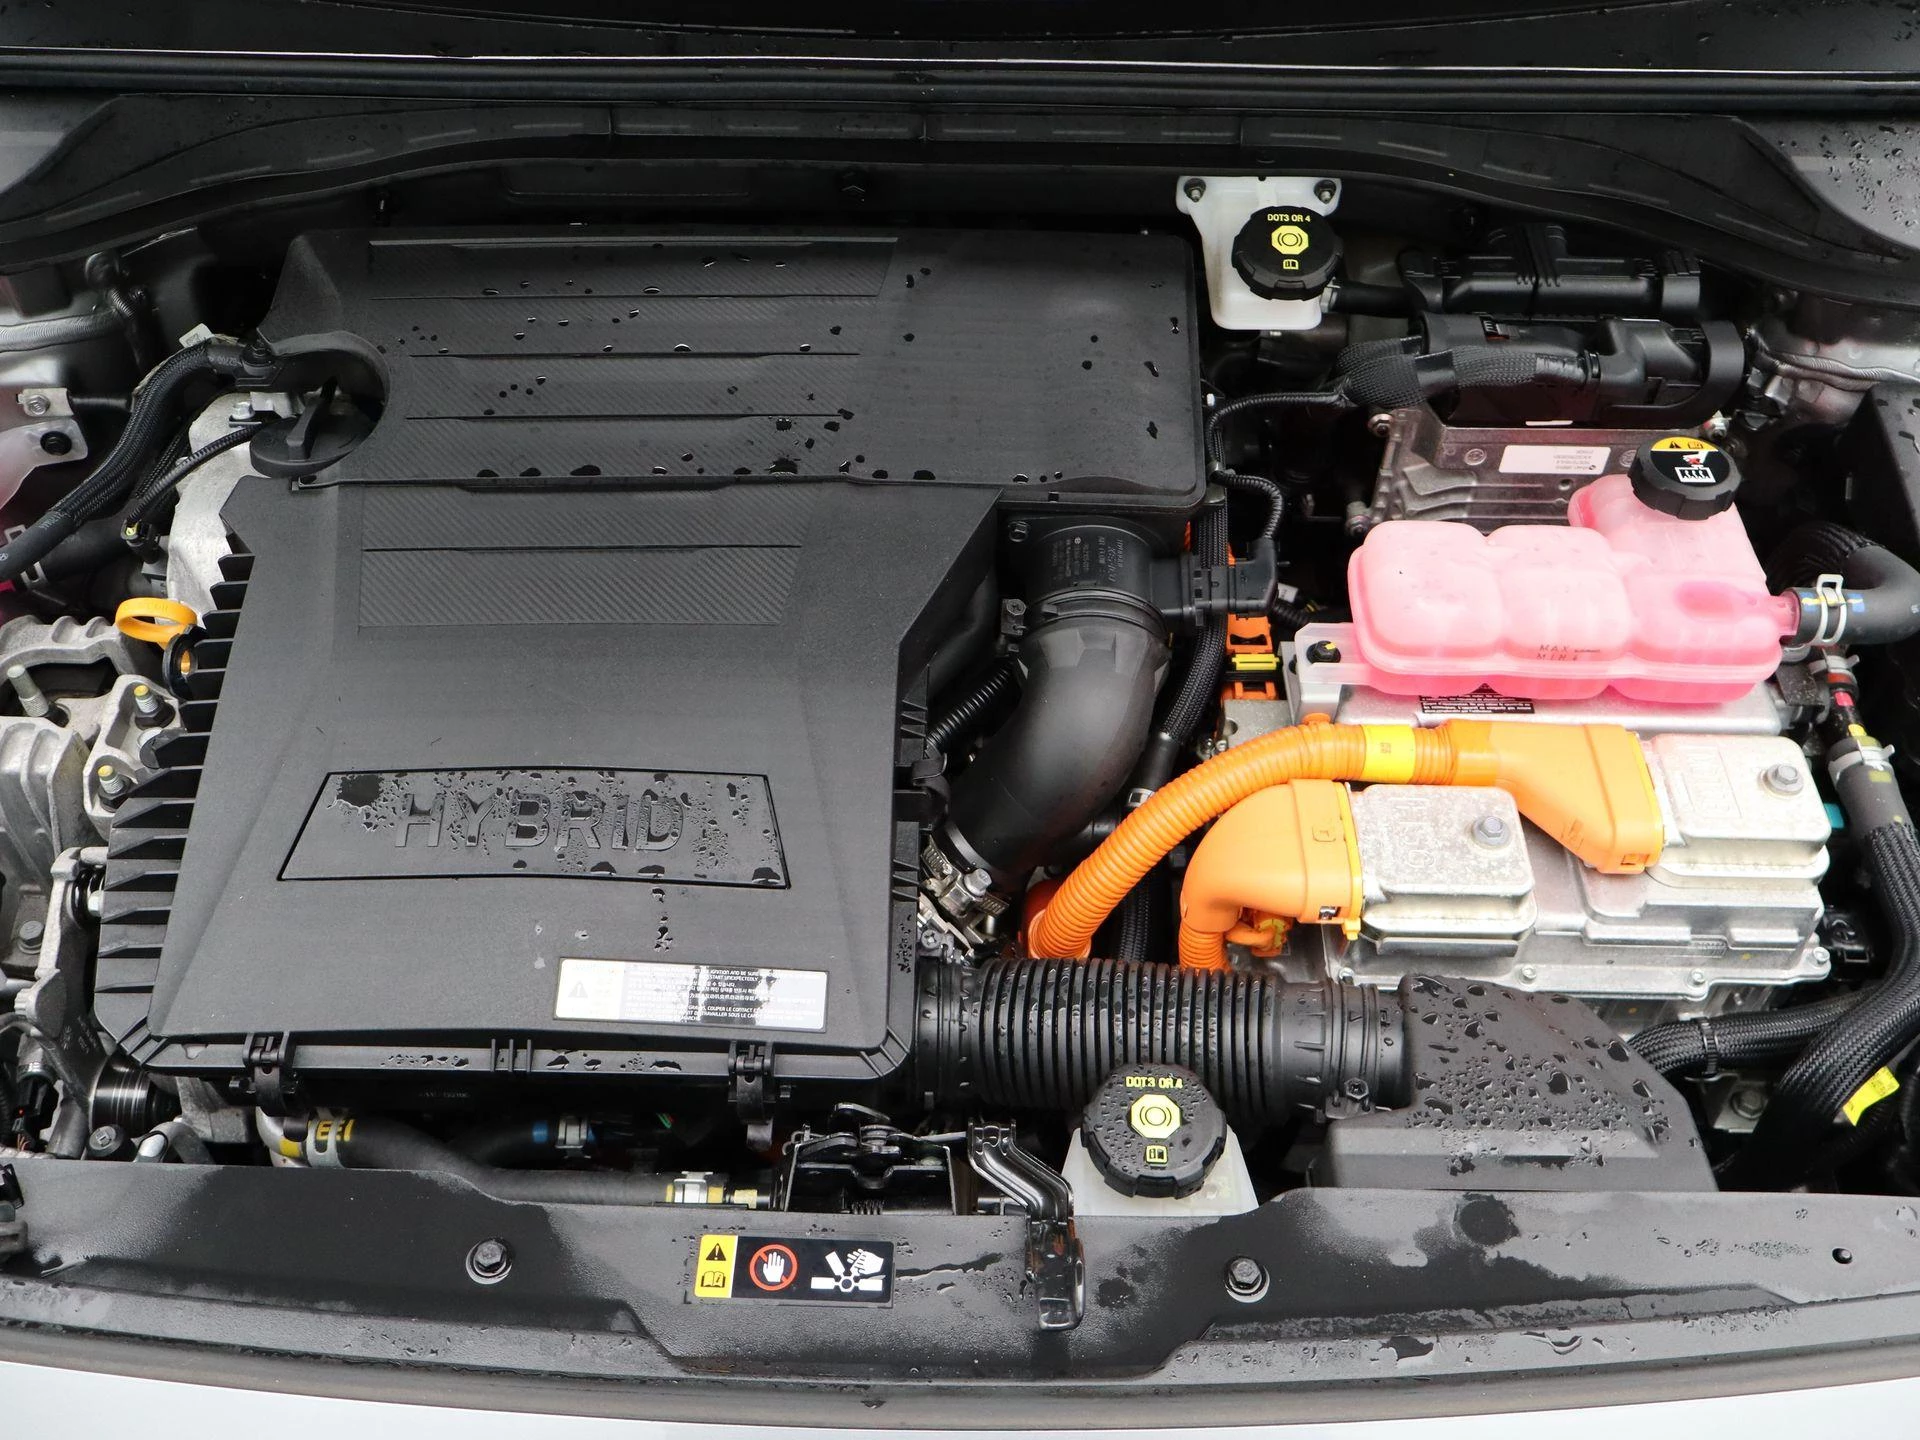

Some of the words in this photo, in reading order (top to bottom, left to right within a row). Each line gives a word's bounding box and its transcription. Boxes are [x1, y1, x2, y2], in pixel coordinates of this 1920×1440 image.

[1267, 213, 1290, 222] DOT3
[1291, 214, 1304, 222] OR
[1539, 644, 1568, 652] MAX
[1537, 653, 1567, 661] MIN
[394, 791, 684, 851] HYBRID
[1125, 1076, 1156, 1088] DOT3
[1158, 1077, 1174, 1089] OR
[1175, 1078, 1183, 1089] 4
